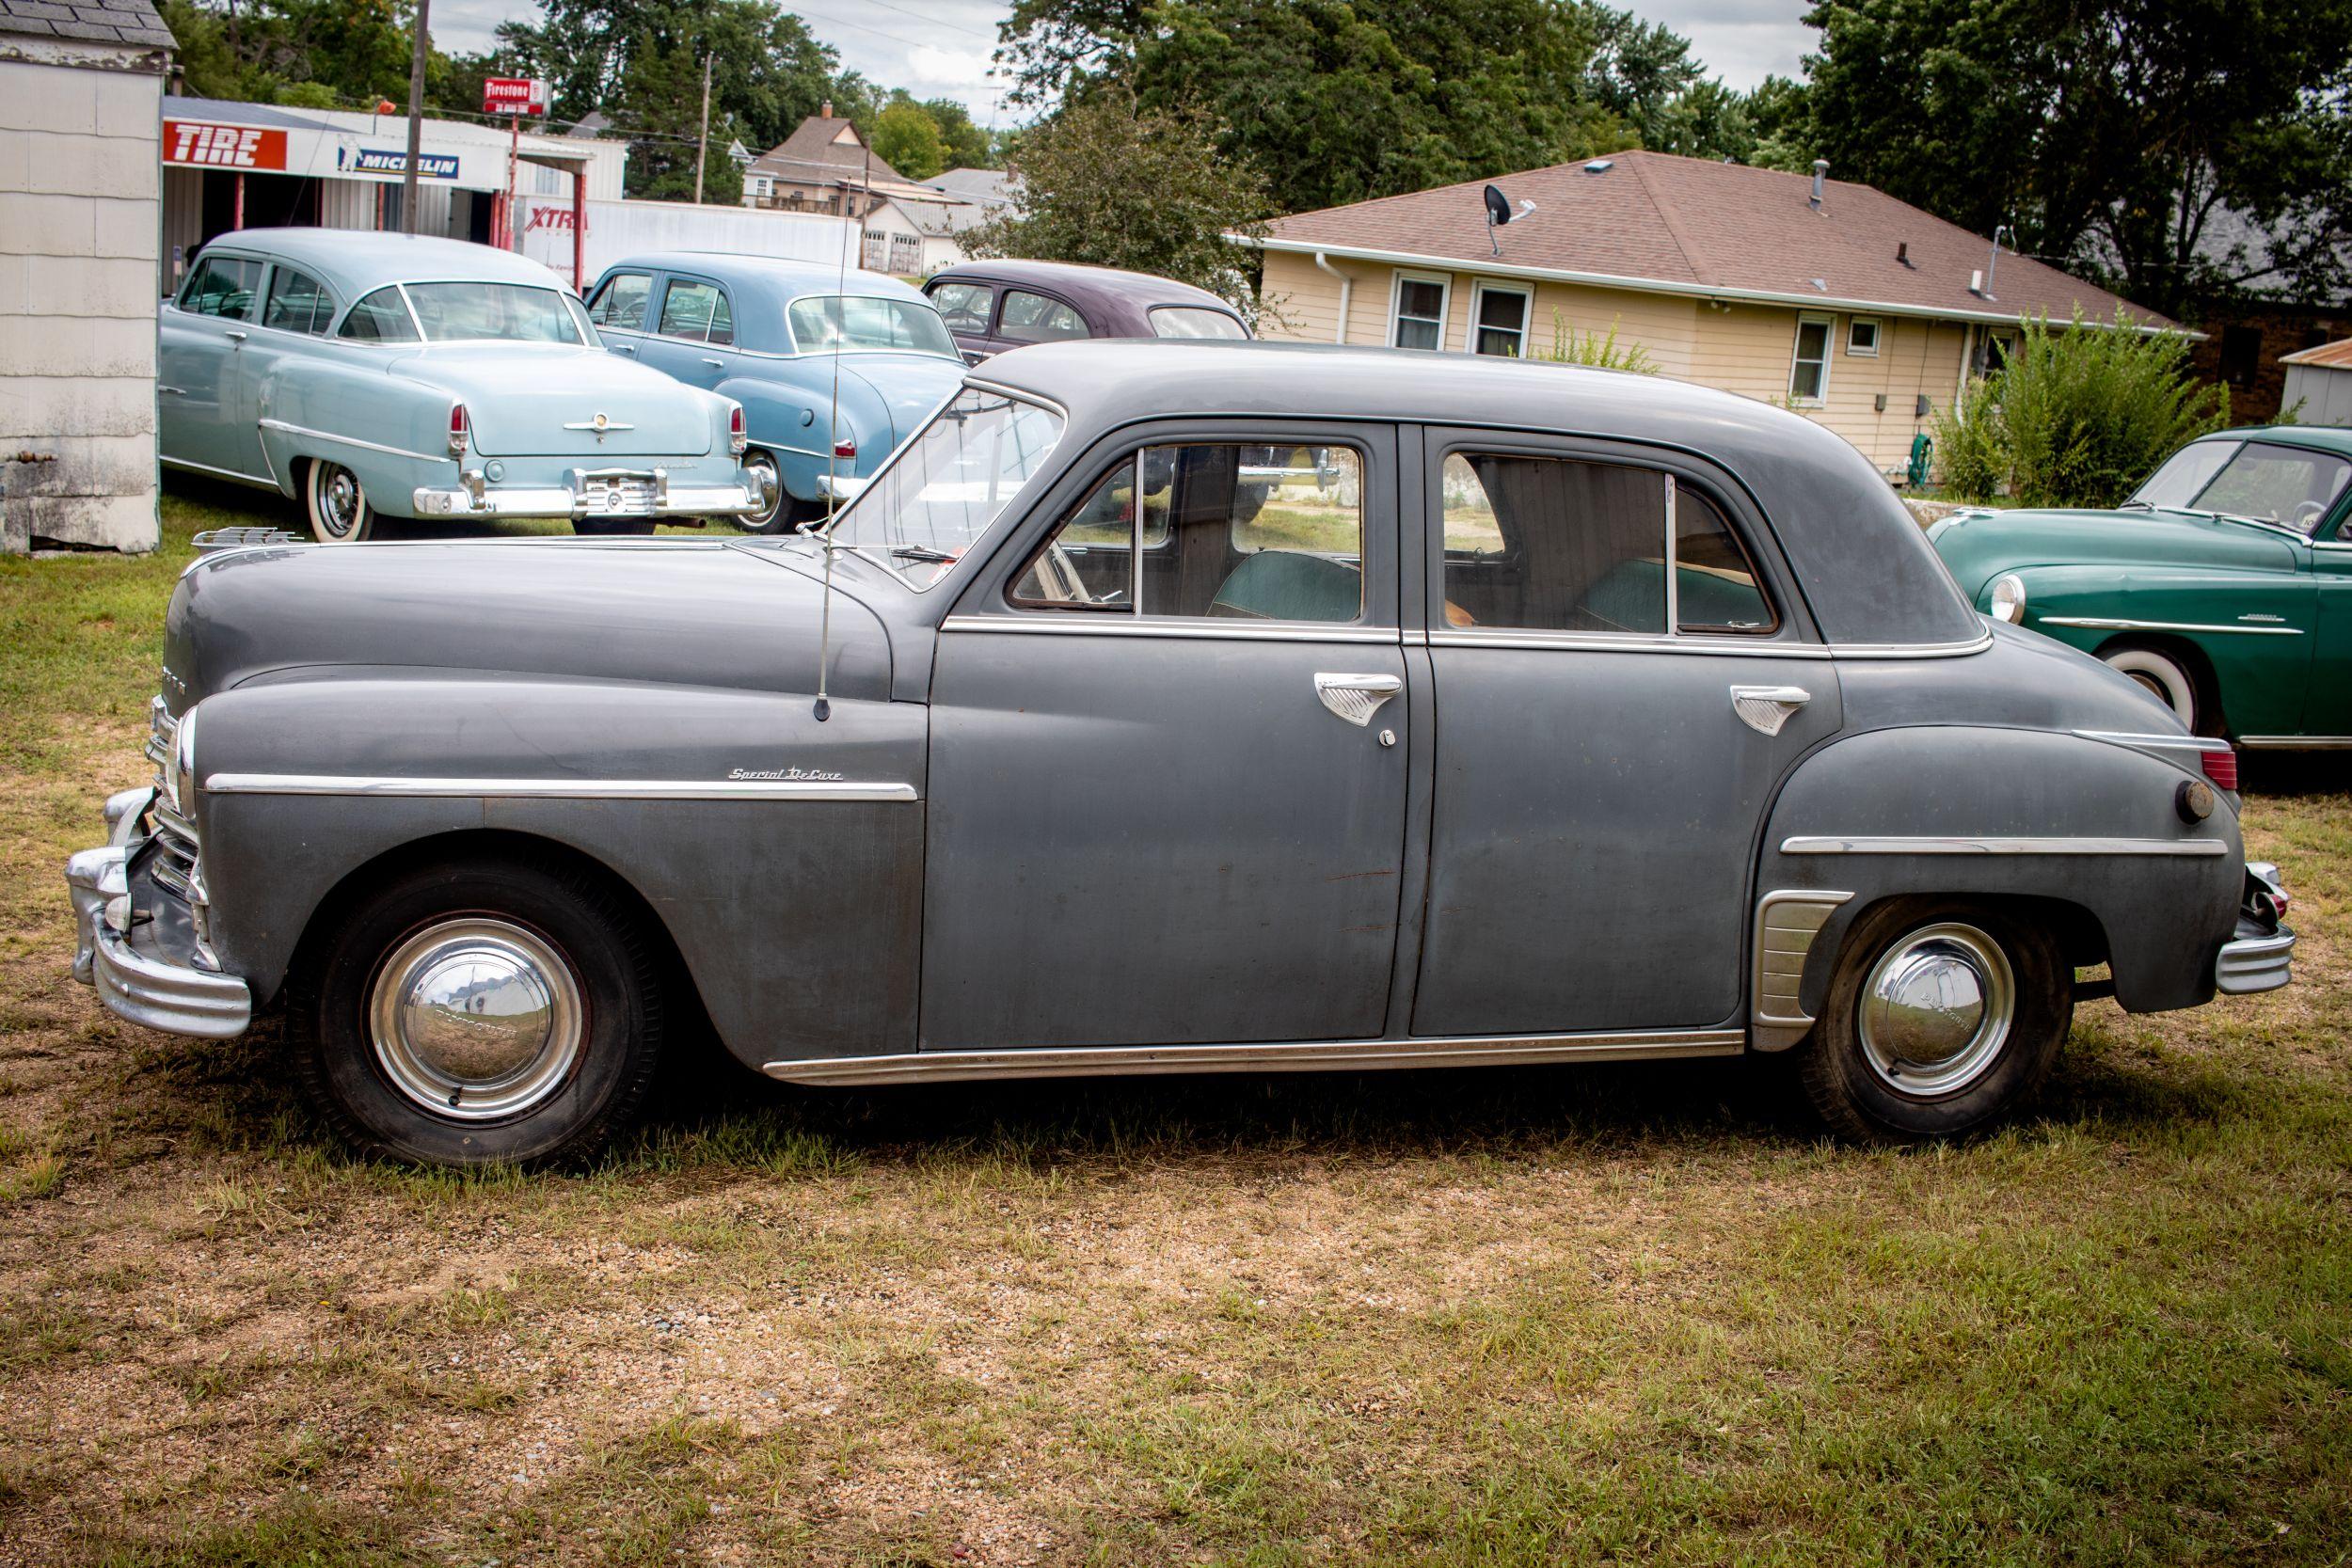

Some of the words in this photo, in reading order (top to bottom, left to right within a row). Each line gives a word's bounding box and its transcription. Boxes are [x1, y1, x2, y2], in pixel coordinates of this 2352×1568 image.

[485, 82, 529, 99] Firestone
[174, 124, 262, 166] TIRE
[728, 768, 785, 780] Special
